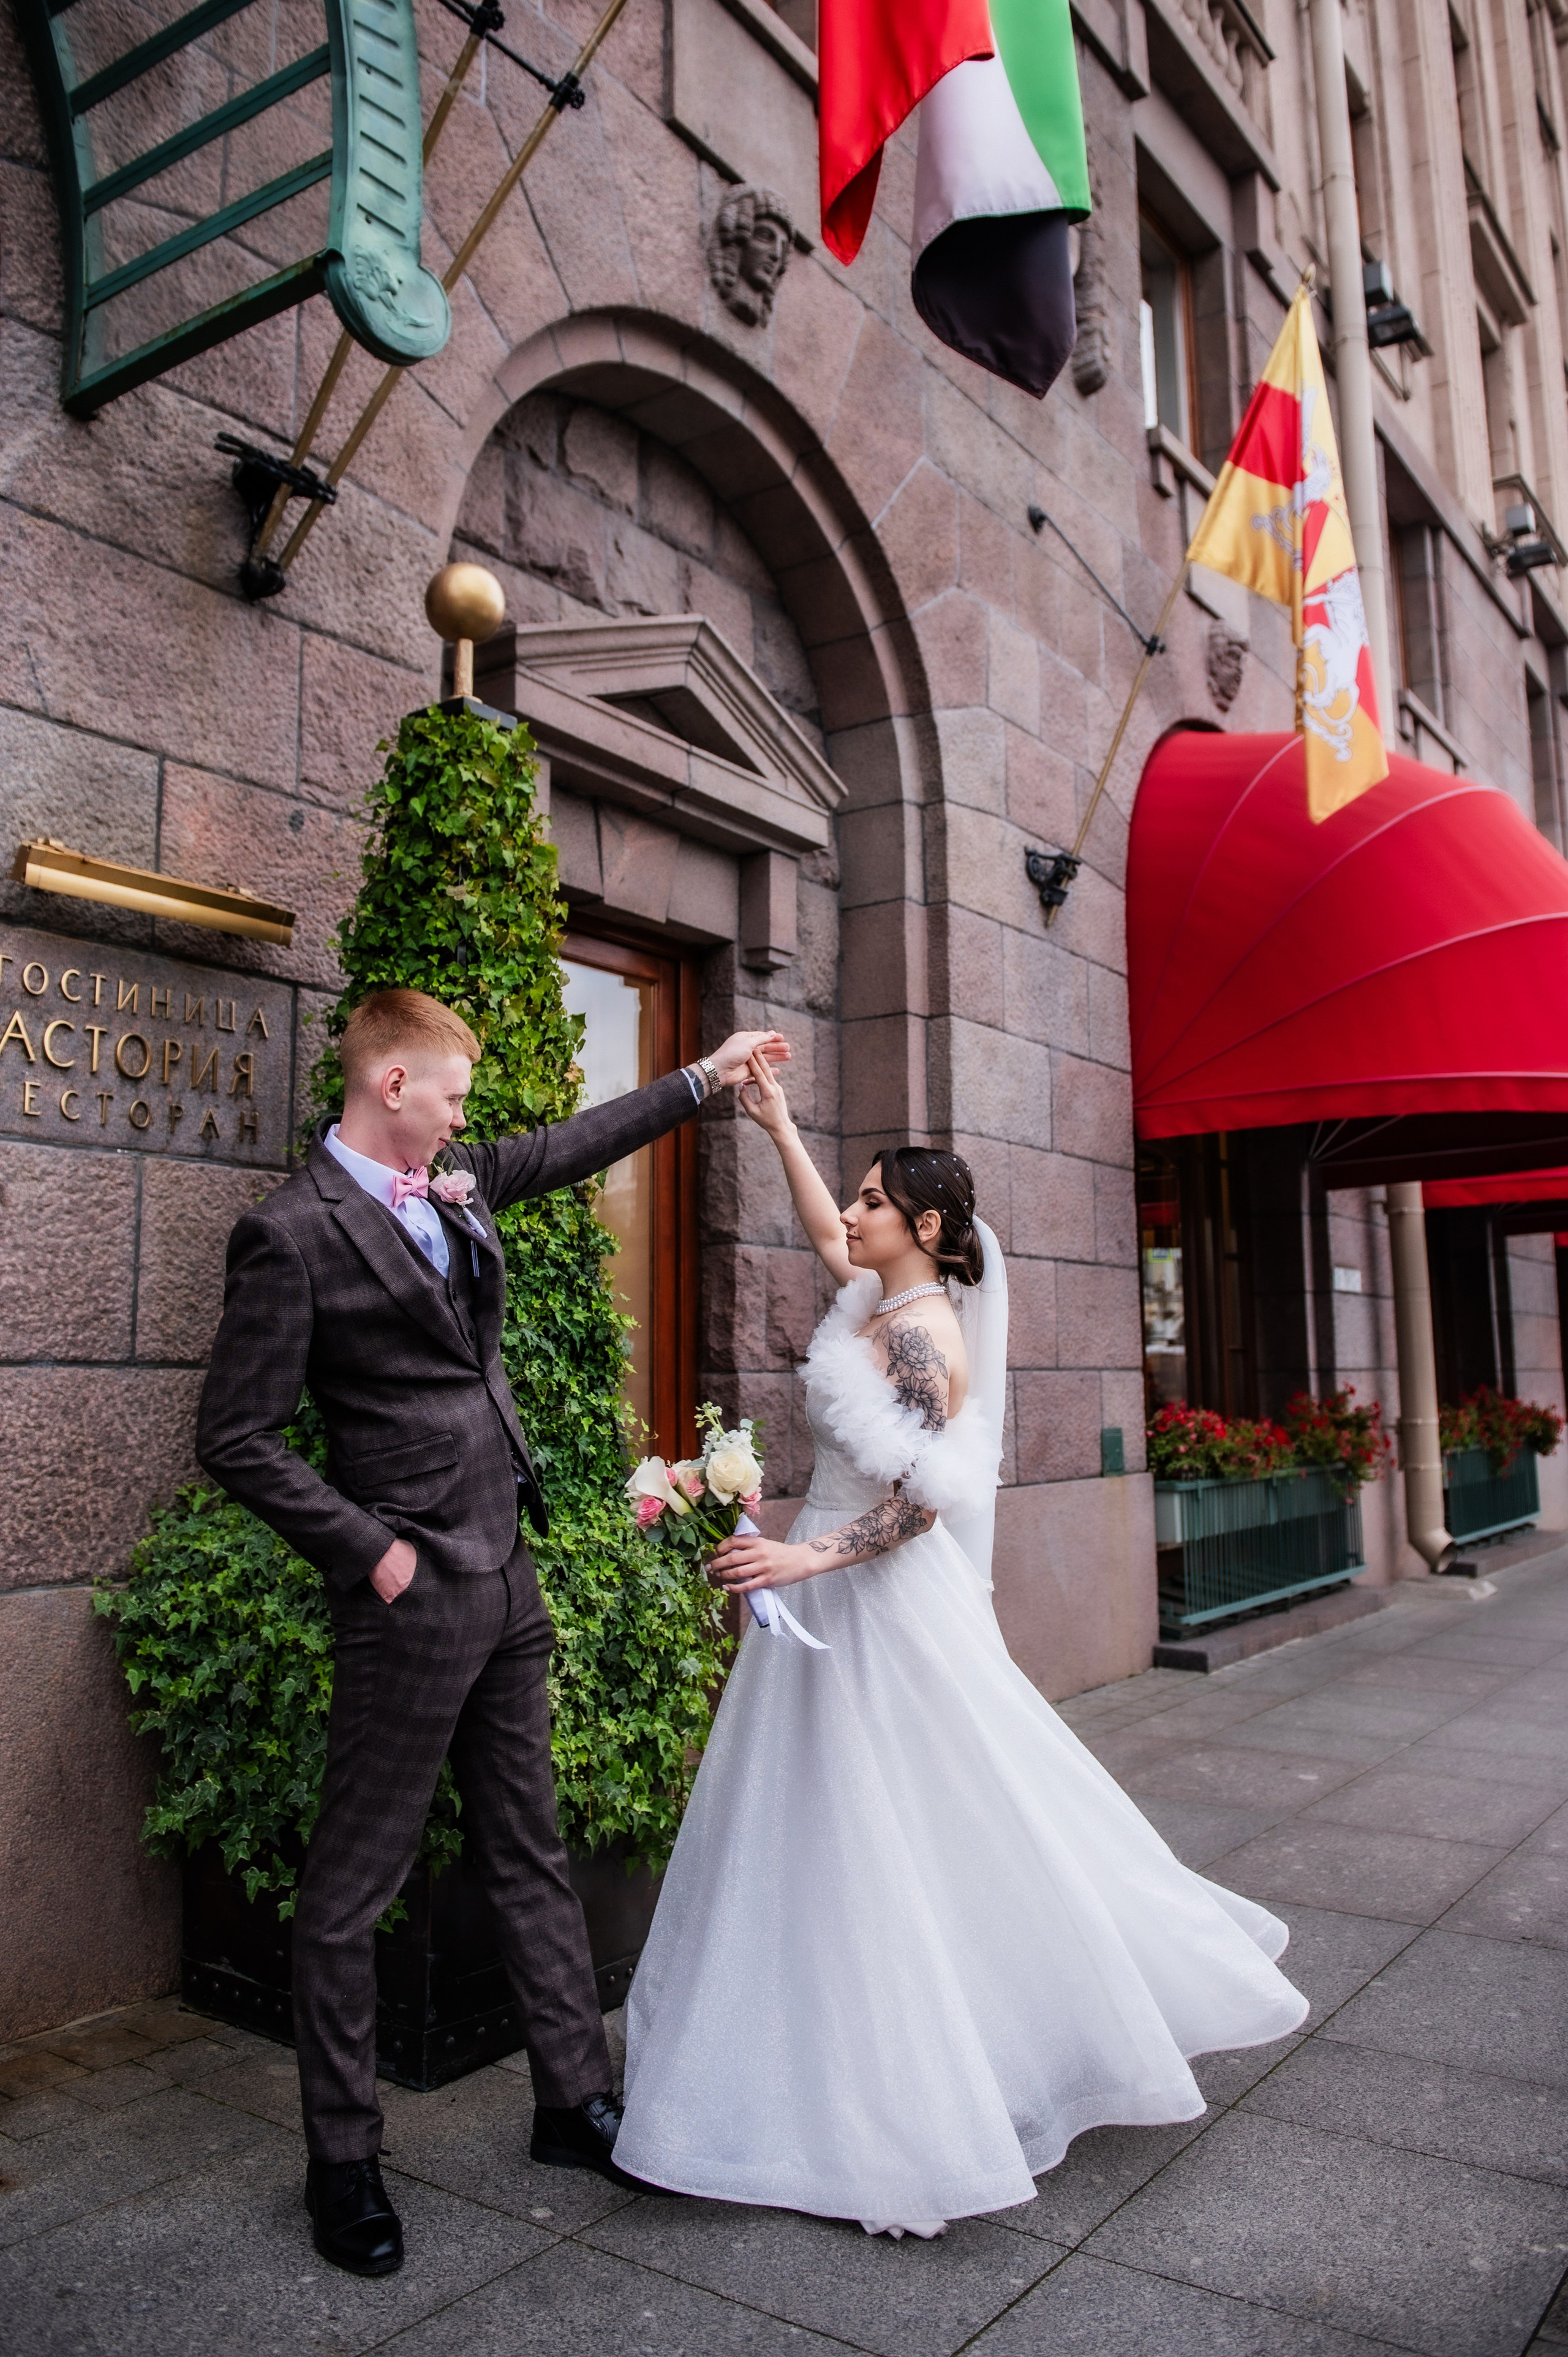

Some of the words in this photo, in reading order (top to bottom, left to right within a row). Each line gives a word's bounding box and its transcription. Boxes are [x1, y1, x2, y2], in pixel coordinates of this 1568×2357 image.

[0, 954, 269, 1039] ГОСТИНИЦА
[0, 1011, 254, 1096] АСТОРИЯ
[24, 1081, 258, 1143] ЕСТОРАН
